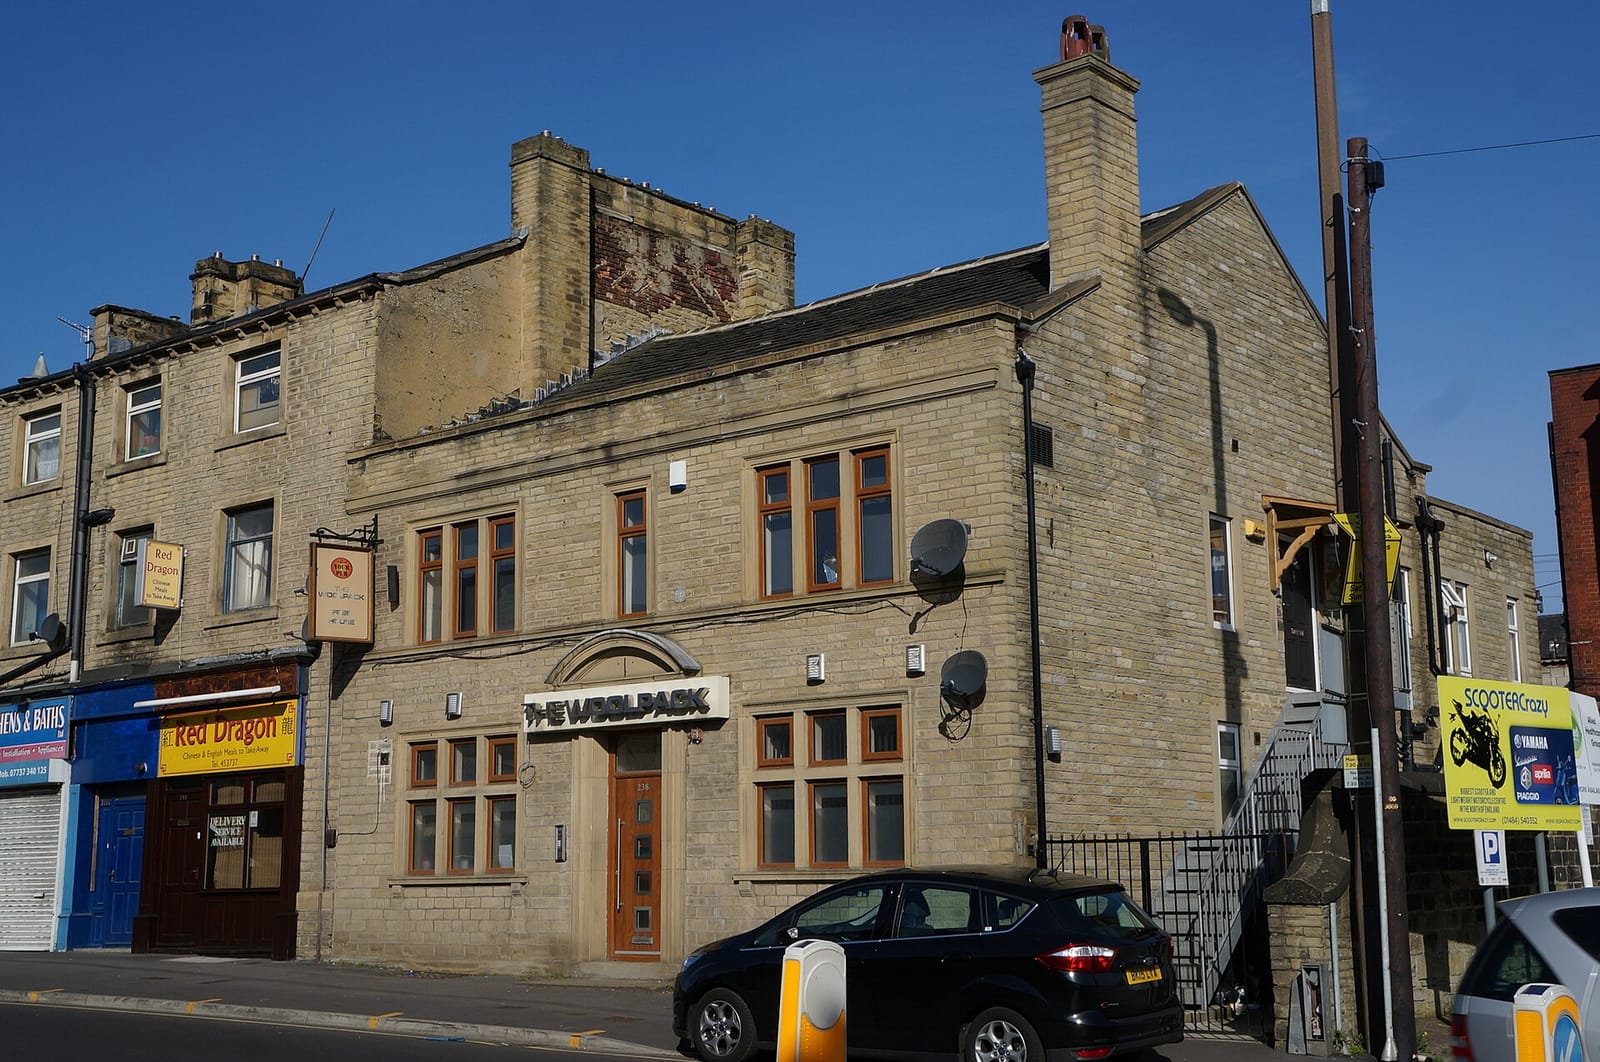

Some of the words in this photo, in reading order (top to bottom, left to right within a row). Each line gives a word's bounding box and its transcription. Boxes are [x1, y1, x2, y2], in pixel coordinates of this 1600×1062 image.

[155, 548, 173, 560] Red
[147, 561, 179, 575] Dragon
[566, 687, 711, 725] WOOLPACK
[23, 709, 31, 732] &
[33, 705, 65, 731] BATHS
[175, 718, 208, 747] Red
[213, 714, 277, 746] Dragon
[1521, 735, 1549, 750] YAMAHA
[182, 751, 201, 760] Chinese
[202, 750, 206, 758] &
[206, 748, 223, 759] English
[223, 747, 238, 756] Meals
[1534, 768, 1551, 780] aprilia
[1516, 792, 1540, 801] PIAGGIO
[210, 815, 247, 826] DELIVERY
[215, 827, 242, 836] SERVICE
[211, 837, 245, 847] AVAILABLE
[1484, 832, 1498, 862] P
